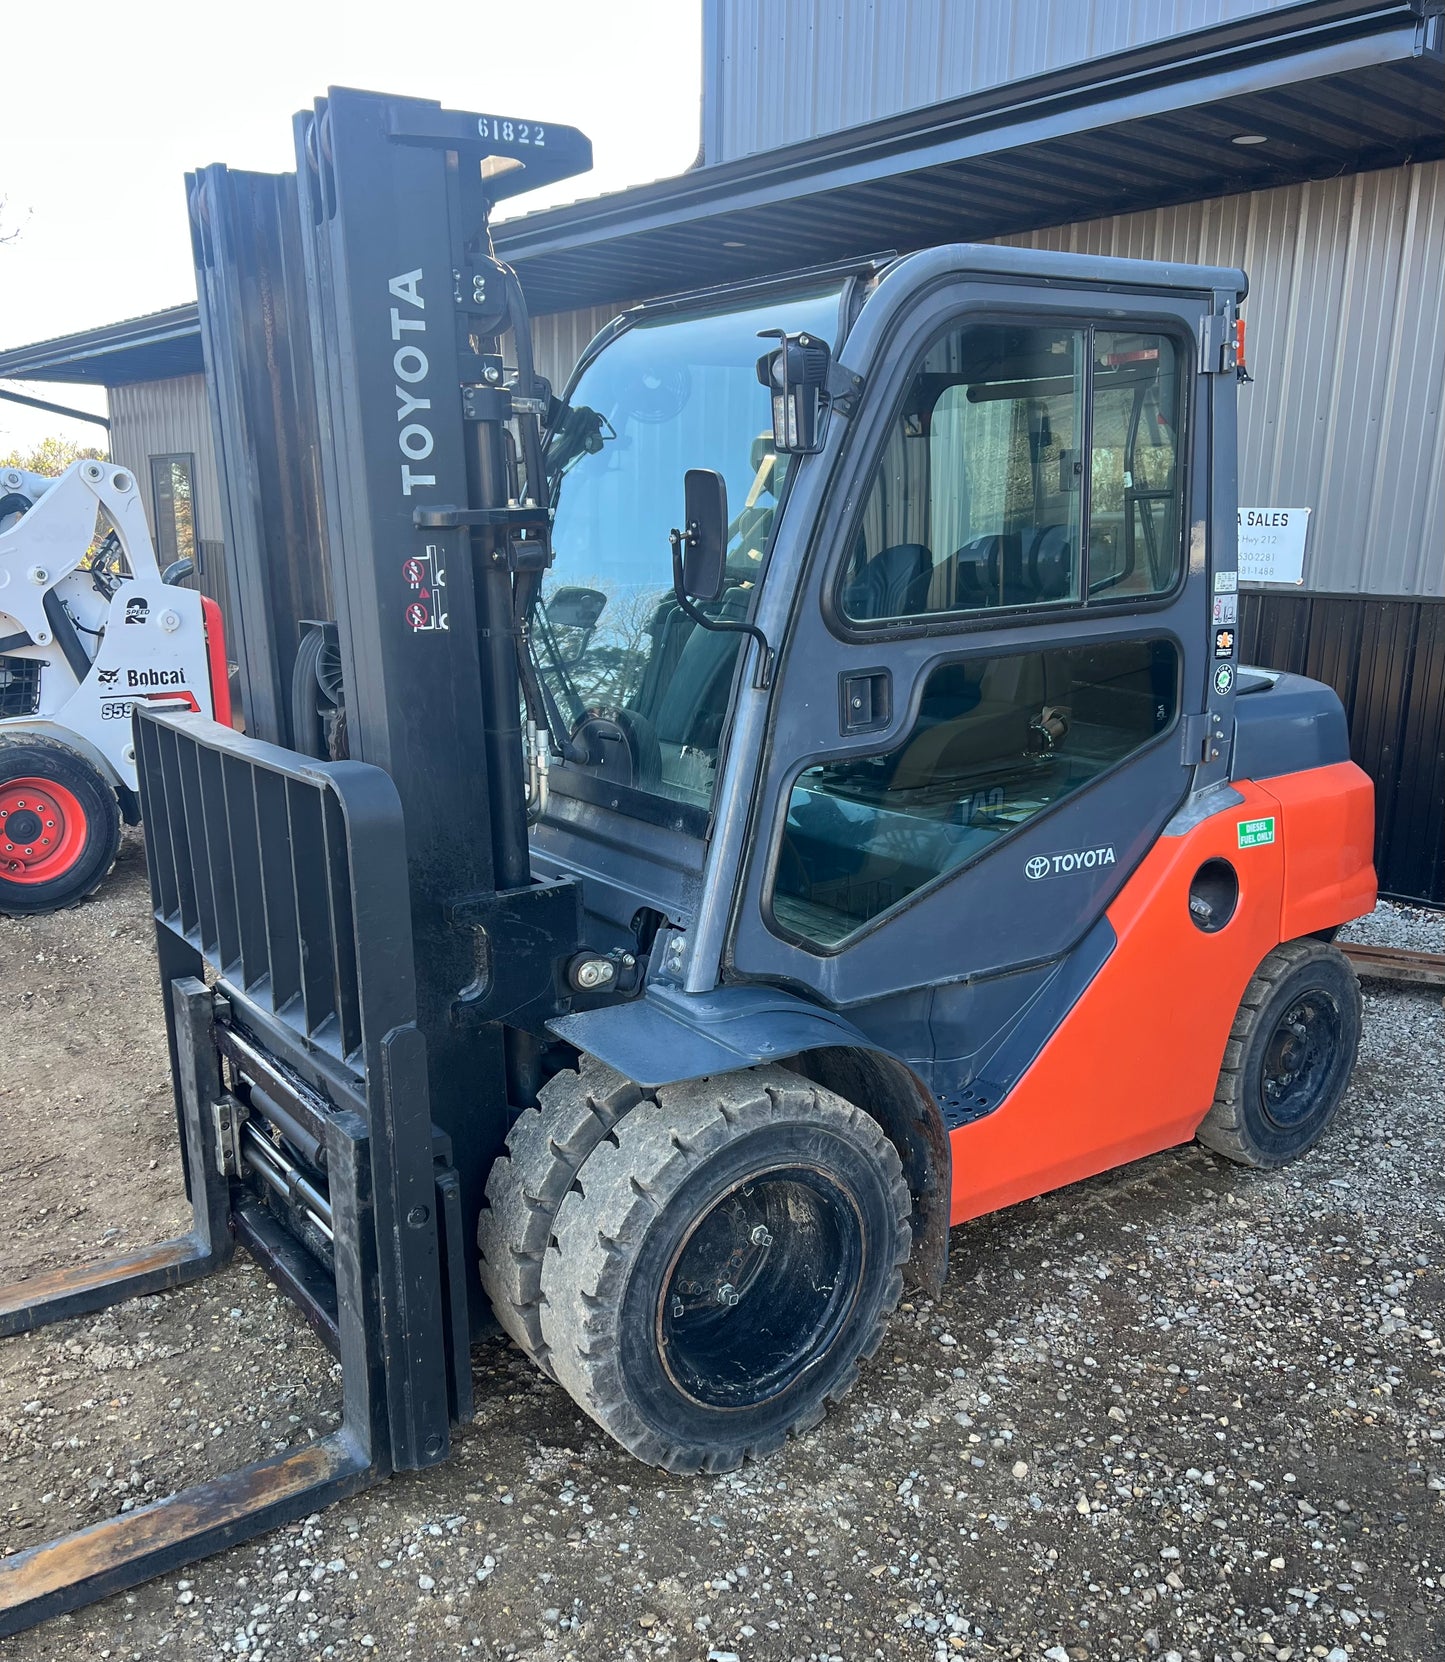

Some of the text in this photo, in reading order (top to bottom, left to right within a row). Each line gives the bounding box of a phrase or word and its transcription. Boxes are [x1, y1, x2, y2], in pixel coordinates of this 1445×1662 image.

[478, 118, 545, 146] 61822
[388, 268, 436, 496] TOYOTA
[1247, 511, 1289, 527] SALES
[1242, 535, 1277, 547] Hwy 212
[127, 667, 187, 687] Bobcat
[1246, 821, 1267, 834] DIESEL
[1240, 831, 1273, 845] FUEL ONLY
[1052, 847, 1116, 873] TOYOTA
